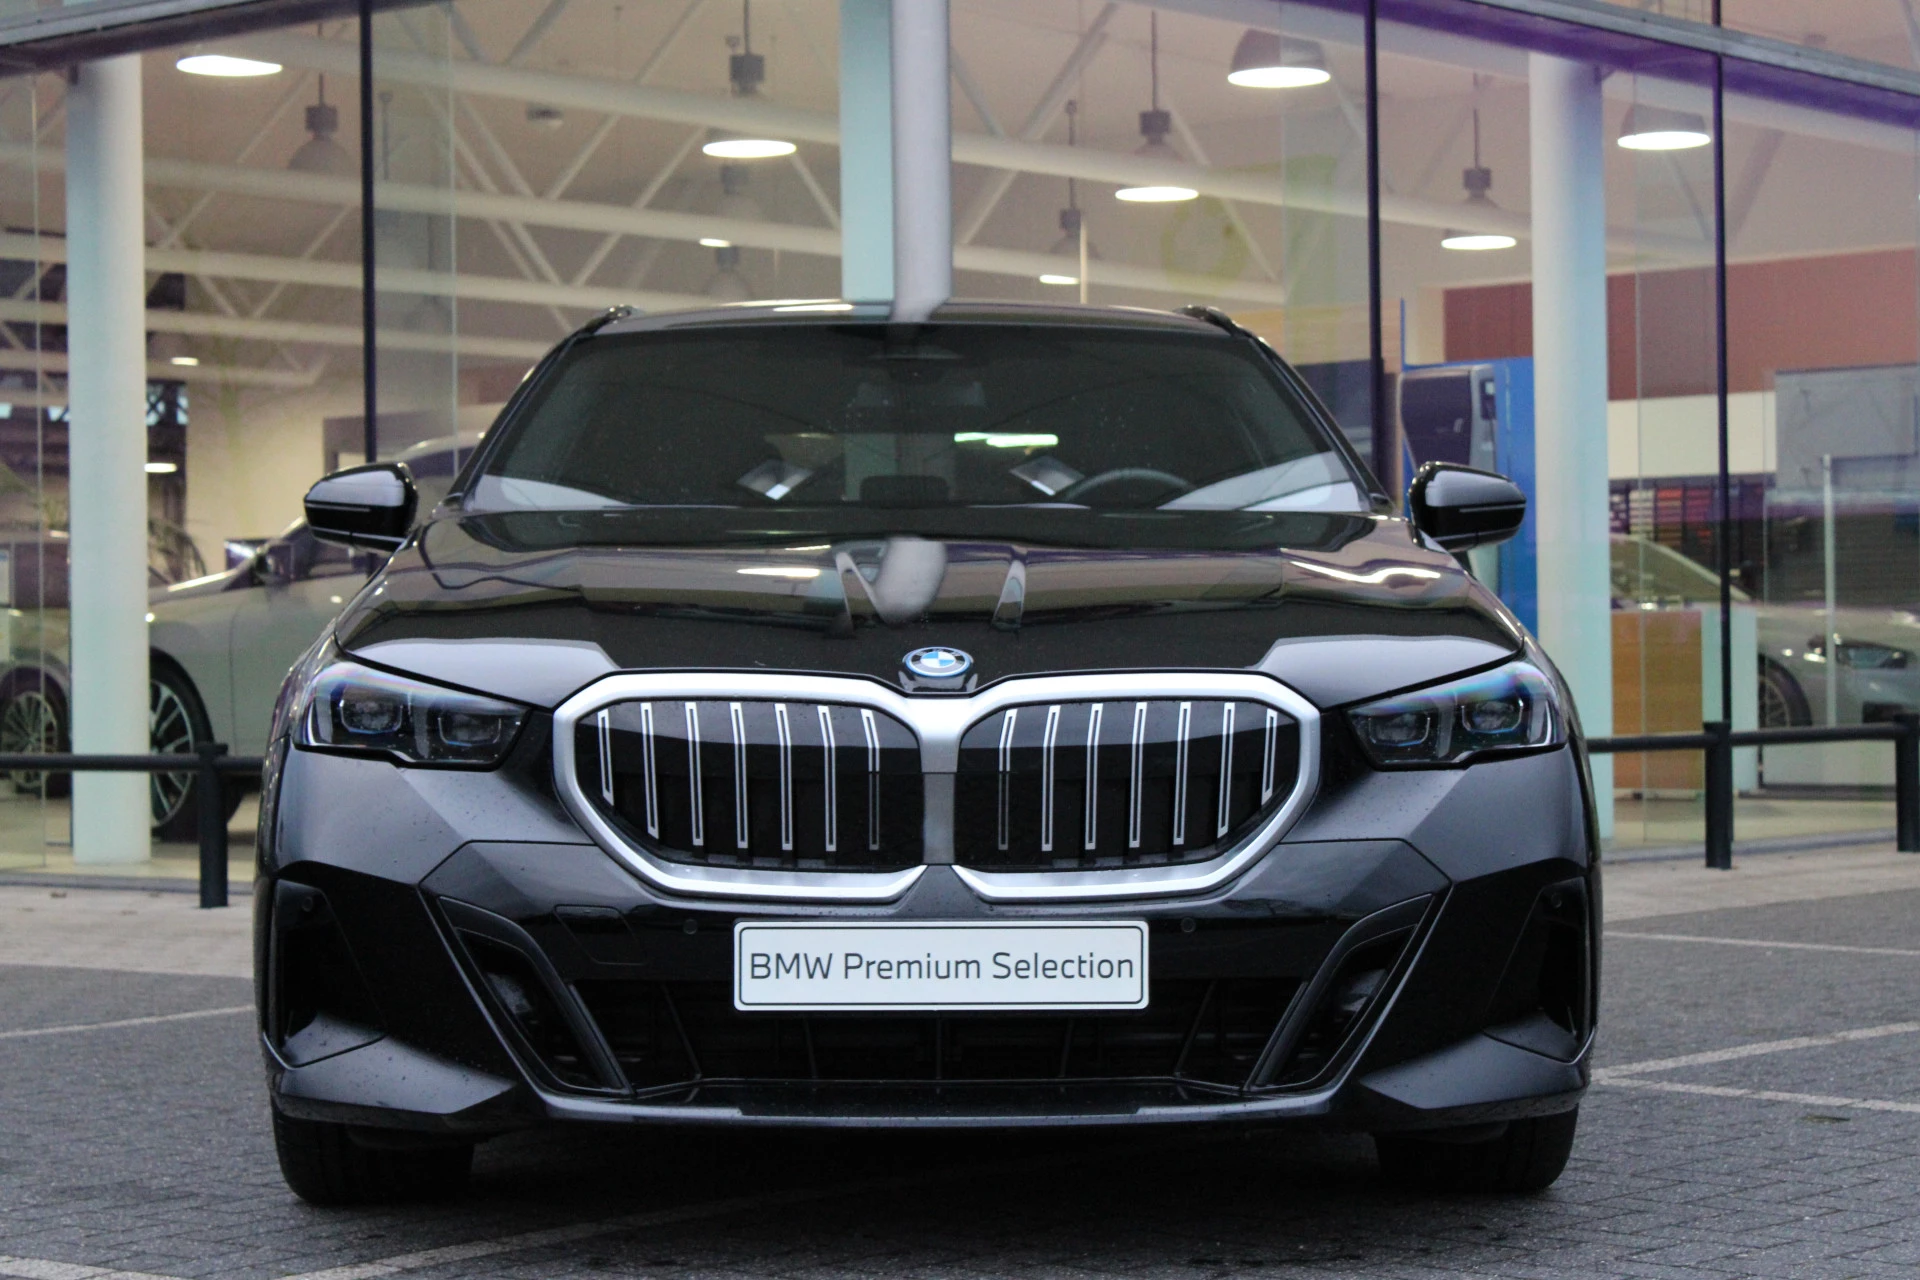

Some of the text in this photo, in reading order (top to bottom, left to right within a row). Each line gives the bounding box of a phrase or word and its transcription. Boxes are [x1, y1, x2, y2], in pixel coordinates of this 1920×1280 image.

[750, 951, 1134, 979] BMW Premium Selection
